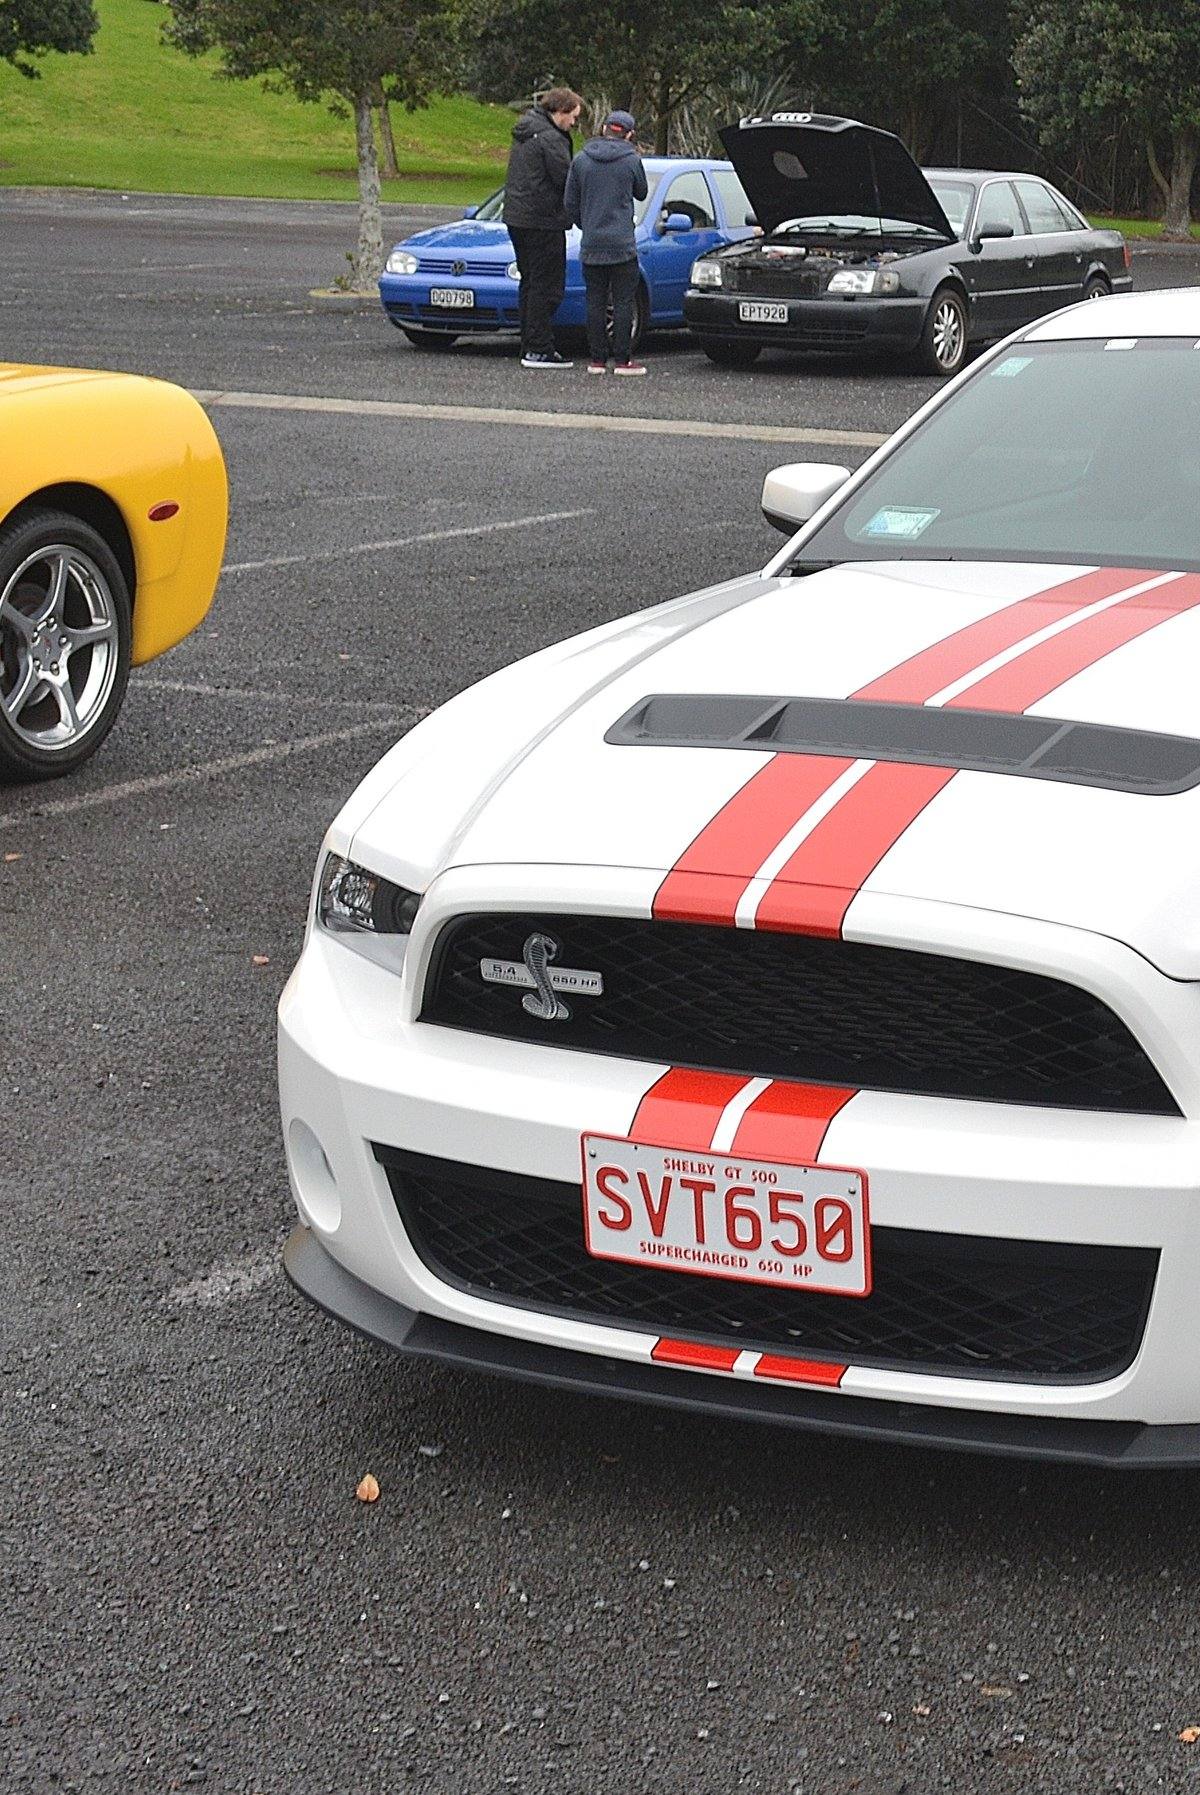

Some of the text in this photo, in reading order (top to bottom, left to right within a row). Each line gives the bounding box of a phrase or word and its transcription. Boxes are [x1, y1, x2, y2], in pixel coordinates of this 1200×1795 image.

[663, 1158, 778, 1184] SHELBY GT 500
[596, 1166, 853, 1263] SVT650
[640, 1240, 813, 1279] SUPERCHARGED 650 HP
